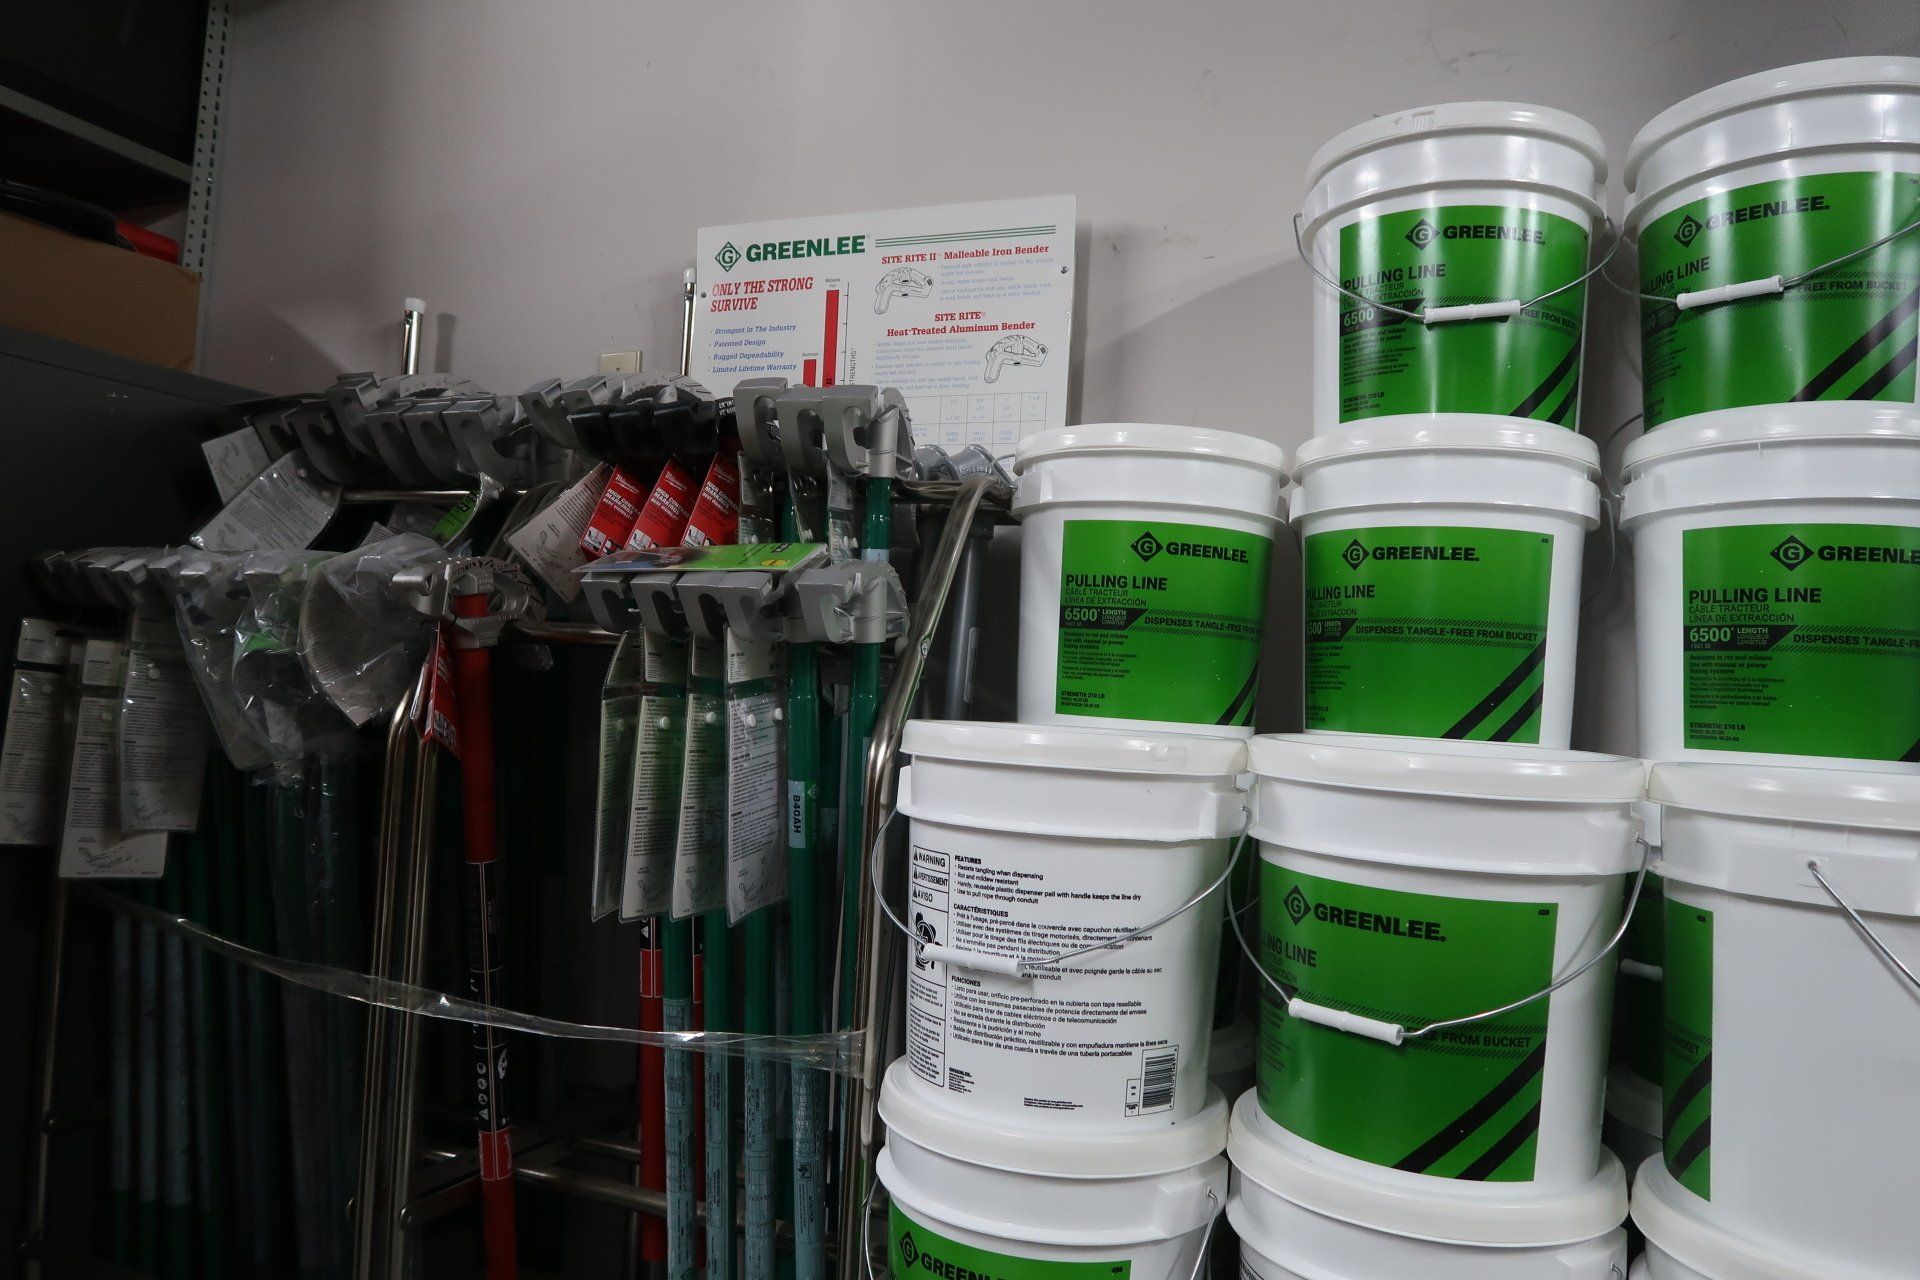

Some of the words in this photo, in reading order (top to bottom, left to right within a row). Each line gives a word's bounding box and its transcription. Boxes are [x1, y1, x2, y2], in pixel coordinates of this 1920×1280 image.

[1706, 196, 1827, 230] GREENLEE
[1443, 225, 1543, 245] GREENLEE
[746, 235, 865, 262] GREENLEE
[882, 256, 902, 264] SITE
[905, 254, 927, 263] RITE
[944, 250, 990, 260] Malleable
[992, 248, 1012, 257] Iron
[1015, 245, 1049, 255] Bender
[1678, 256, 1710, 279] LINE
[1344, 268, 1403, 291] PULLING
[1409, 264, 1446, 280] LINE
[712, 282, 741, 296] ONLY
[743, 280, 765, 294] THE
[767, 276, 813, 292] STRONG
[1829, 280, 1863, 291] FROM
[1867, 280, 1907, 291] BUCKET
[711, 297, 758, 312] SURVIVE
[935, 314, 956, 322] SITE
[959, 312, 982, 321] RITE
[1344, 308, 1374, 326] 6500
[715, 327, 745, 335] Strongest
[769, 324, 796, 332] Industry
[950, 324, 998, 334] Aluminum
[1002, 322, 1035, 331] Bender
[744, 339, 766, 347] Design
[739, 351, 784, 360] Dependability
[654, 492, 680, 515] MARKINGS
[1166, 542, 1248, 563] GREENLEE
[1372, 546, 1476, 562] GREENLEE
[1818, 546, 1920, 565] GREENLE
[1066, 574, 1128, 589] PULLING
[1132, 576, 1168, 590] LINE
[1089, 588, 1128, 597] TRACTEUR
[1344, 585, 1375, 599] LINE
[1689, 588, 1768, 604] PULLING
[1775, 588, 1822, 603] LINE
[1097, 597, 1146, 606] EXTRACCIÓN
[1720, 604, 1770, 613] TRACTEUR
[1145, 617, 1193, 628] DISPENSES
[1716, 614, 1727, 622] DE
[1730, 612, 1794, 622] EXTRACCIÓN
[1356, 625, 1404, 635] DISPENSES
[1407, 627, 1475, 637] TANGLE-FREE
[1477, 630, 1503, 640] FROM
[1506, 631, 1538, 641] BUCKET
[1794, 634, 1860, 645] DISPENSES
[919, 853, 946, 867] WARNING
[955, 855, 981, 864] FEATURES
[976, 867, 995, 875] tangling
[1012, 870, 1044, 880] dispensing
[976, 875, 993, 883] mildew
[974, 883, 994, 891] reusable
[996, 886, 1014, 894] plastic
[1015, 888, 1043, 897] dispenser
[995, 894, 1015, 902] through
[954, 903, 1008, 917] CARACTÉRISTIQUES
[990, 918, 1014, 927] pré-percé
[1314, 903, 1443, 942] GREENLEE
[996, 927, 1021, 936] systèmes
[997, 943, 1020, 952] pendant
[1027, 947, 1060, 956] distribution
[1028, 939, 1060, 947] électriques
[1286, 941, 1317, 968] LINE
[952, 975, 980, 987] FUNCIONES
[987, 1000, 1011, 1008] sistemas
[1010, 996, 1049, 1004] pre-perforado
[985, 1016, 1004, 1025] durante
[1012, 1019, 1045, 1029] distribución
[1004, 1010, 1022, 1018] cables
[1023, 1012, 1051, 1021] eléctricos
[1067, 1016, 1117, 1024] telecomunicación
[954, 1017, 977, 1027] Resistente
[988, 1025, 1012, 1034] pudrición
[973, 1030, 1003, 1040] distribución
[1004, 1035, 1027, 1044] práctico,
[1028, 1039, 1060, 1047] reutilizable
[1078, 1041, 1113, 1050] empuñadura
[1442, 1032, 1480, 1045] FROM
[1483, 1036, 1532, 1048] BUCKET
[1040, 1047, 1058, 1056] través
